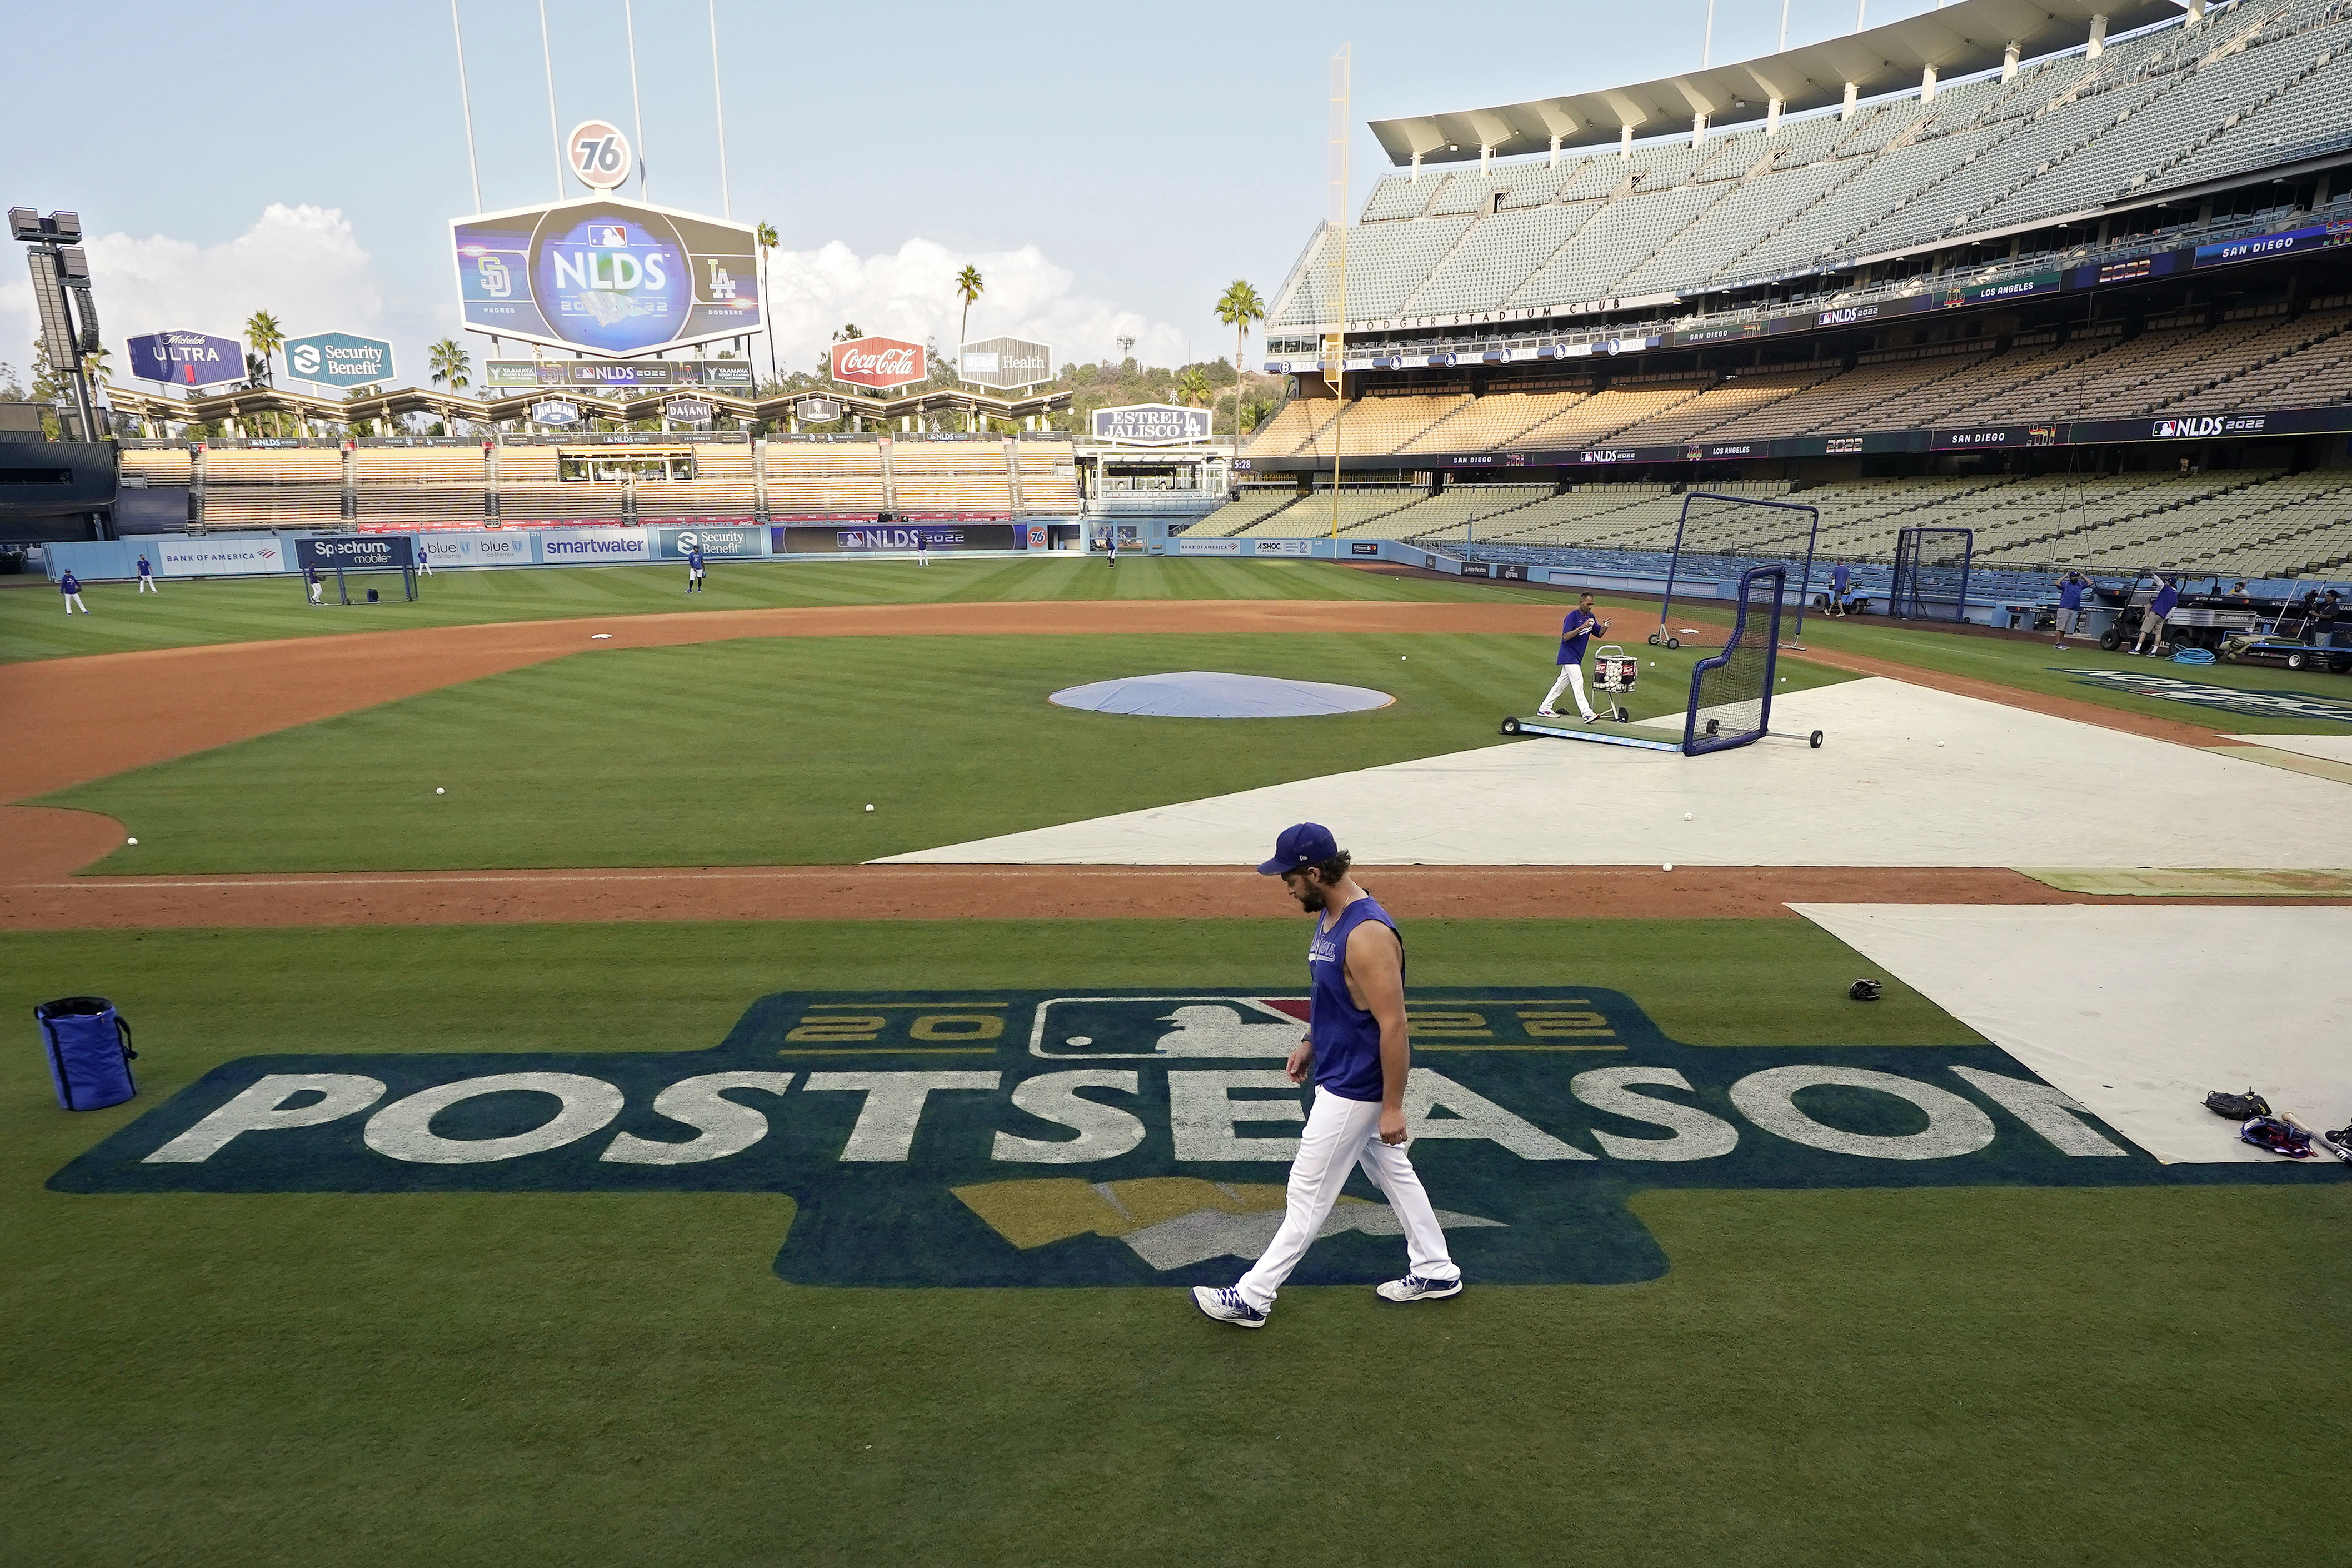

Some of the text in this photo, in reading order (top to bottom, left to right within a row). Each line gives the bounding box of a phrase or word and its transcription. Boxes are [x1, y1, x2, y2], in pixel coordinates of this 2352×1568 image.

[575, 134, 623, 173] 76
[2223, 237, 2294, 258] SAN DIEGO
[553, 251, 666, 291] NLDS
[708, 259, 736, 298] LA
[1980, 282, 2034, 298] LOS ANGELES
[645, 299, 668, 312] 22
[1350, 299, 1621, 331] DODGER STADIUM CLUB
[1830, 307, 1878, 324] NLDS 2022
[161, 334, 206, 346] Michelob
[1690, 330, 1728, 341] SAN DIEGO
[1570, 346, 1587, 354] 1988
[1625, 341, 1642, 349] 2020
[153, 347, 221, 362] ULTRA
[326, 345, 383, 362] Security
[1516, 350, 1532, 359] 1981
[328, 361, 378, 375] Benefit
[840, 347, 918, 376] Coca-Cola
[966, 356, 1045, 369] UCLA Health
[596, 366, 635, 380] NLDS
[536, 402, 576, 420] JIM BEAM
[670, 407, 708, 417] DASANI
[1104, 425, 1180, 437] JALISCO
[2176, 417, 2265, 437] NLDS 2022
[1952, 432, 2005, 443] SAN DIEGO
[1593, 451, 1617, 462] NLDS
[1725, 446, 1750, 454] ANGELES
[1234, 459, 1251, 470] 5:28
[701, 532, 744, 544] Security
[867, 530, 965, 548] NLDS 2022
[1030, 530, 1046, 543] 76
[314, 541, 387, 558] Spectrum
[428, 542, 457, 553] blue
[481, 541, 510, 552] blue
[547, 538, 643, 554] smartwater
[703, 543, 740, 554] Benefit
[167, 554, 194, 562] BANK
[212, 552, 256, 561] AMERICA
[354, 554, 388, 563] mobile
[785, 1010, 1617, 1042] 20 22
